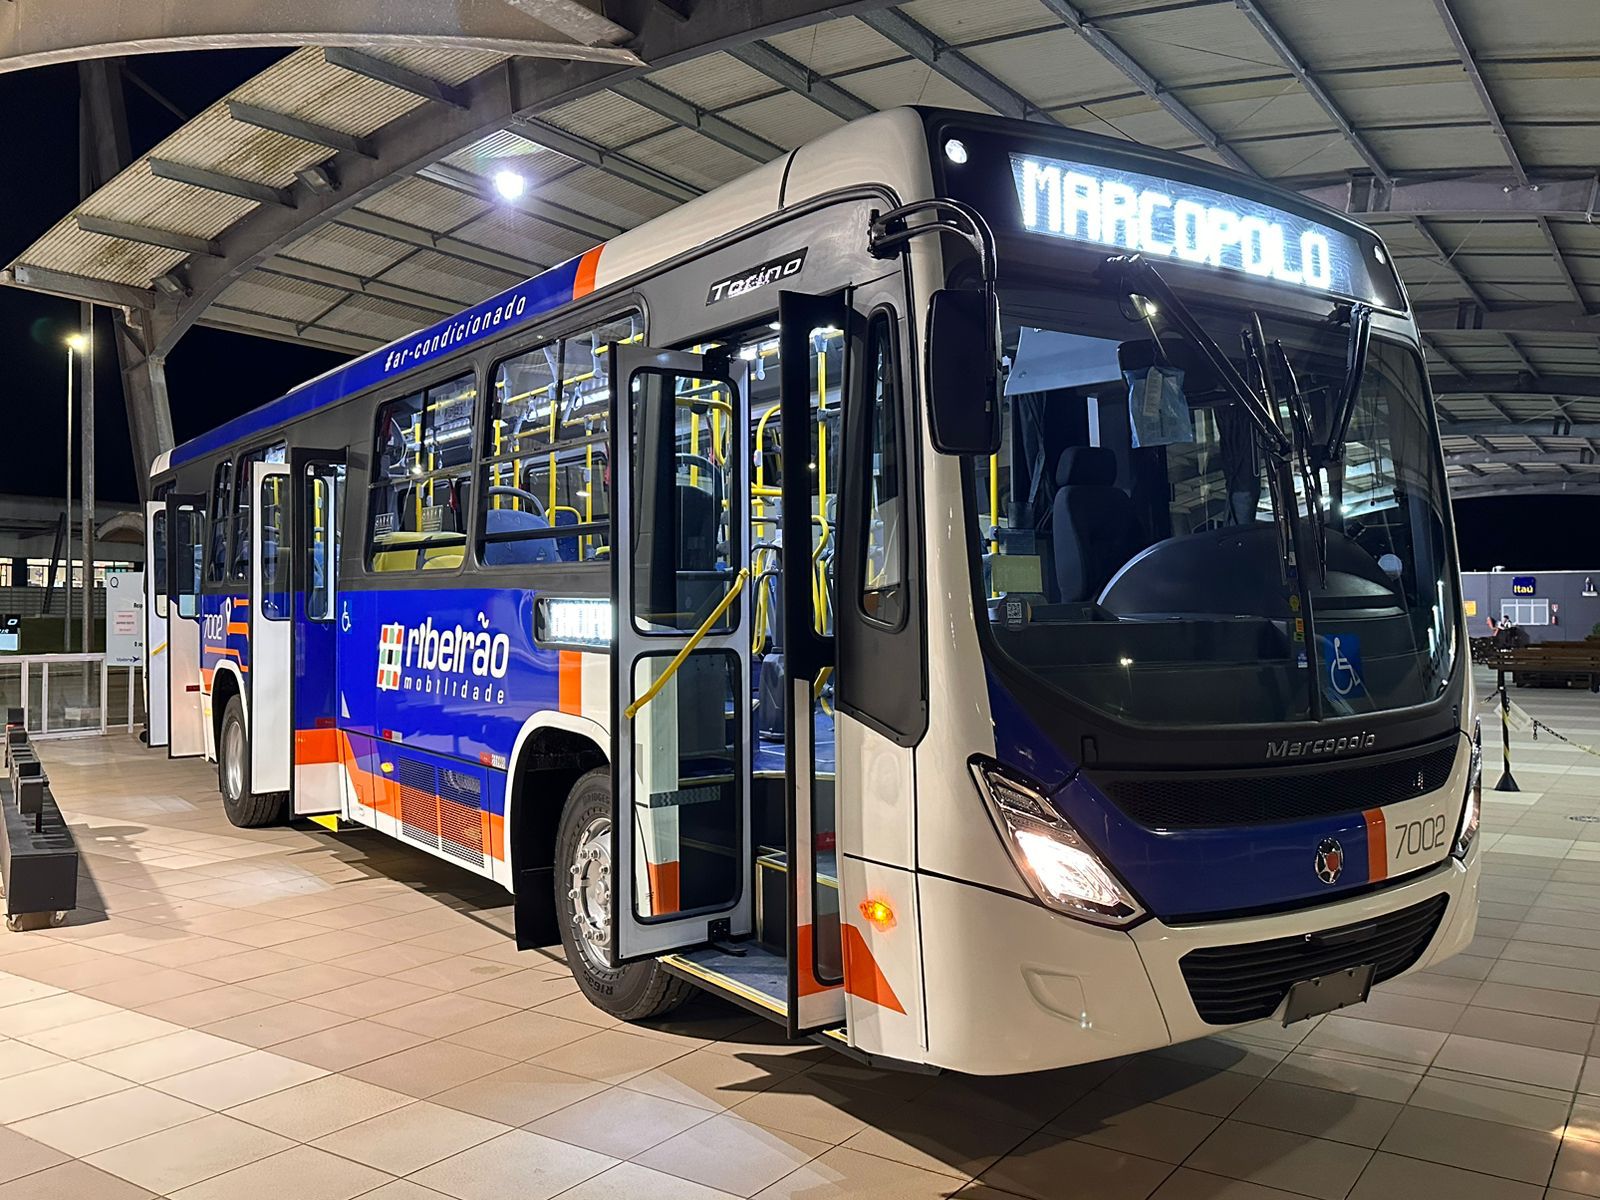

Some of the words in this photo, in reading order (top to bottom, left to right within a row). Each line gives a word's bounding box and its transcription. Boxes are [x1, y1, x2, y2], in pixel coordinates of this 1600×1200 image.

[1022, 158, 1332, 290] MARCOPOLO
[711, 257, 802, 301] Torino
[384, 294, 526, 372] #ar-condicionado
[1513, 585, 1534, 593] Itaú
[203, 613, 223, 640] 7002
[405, 611, 510, 679] ribeirão
[403, 674, 505, 705] mobilidade
[1266, 731, 1375, 758] Marcopolo
[1395, 814, 1446, 859] 7002
